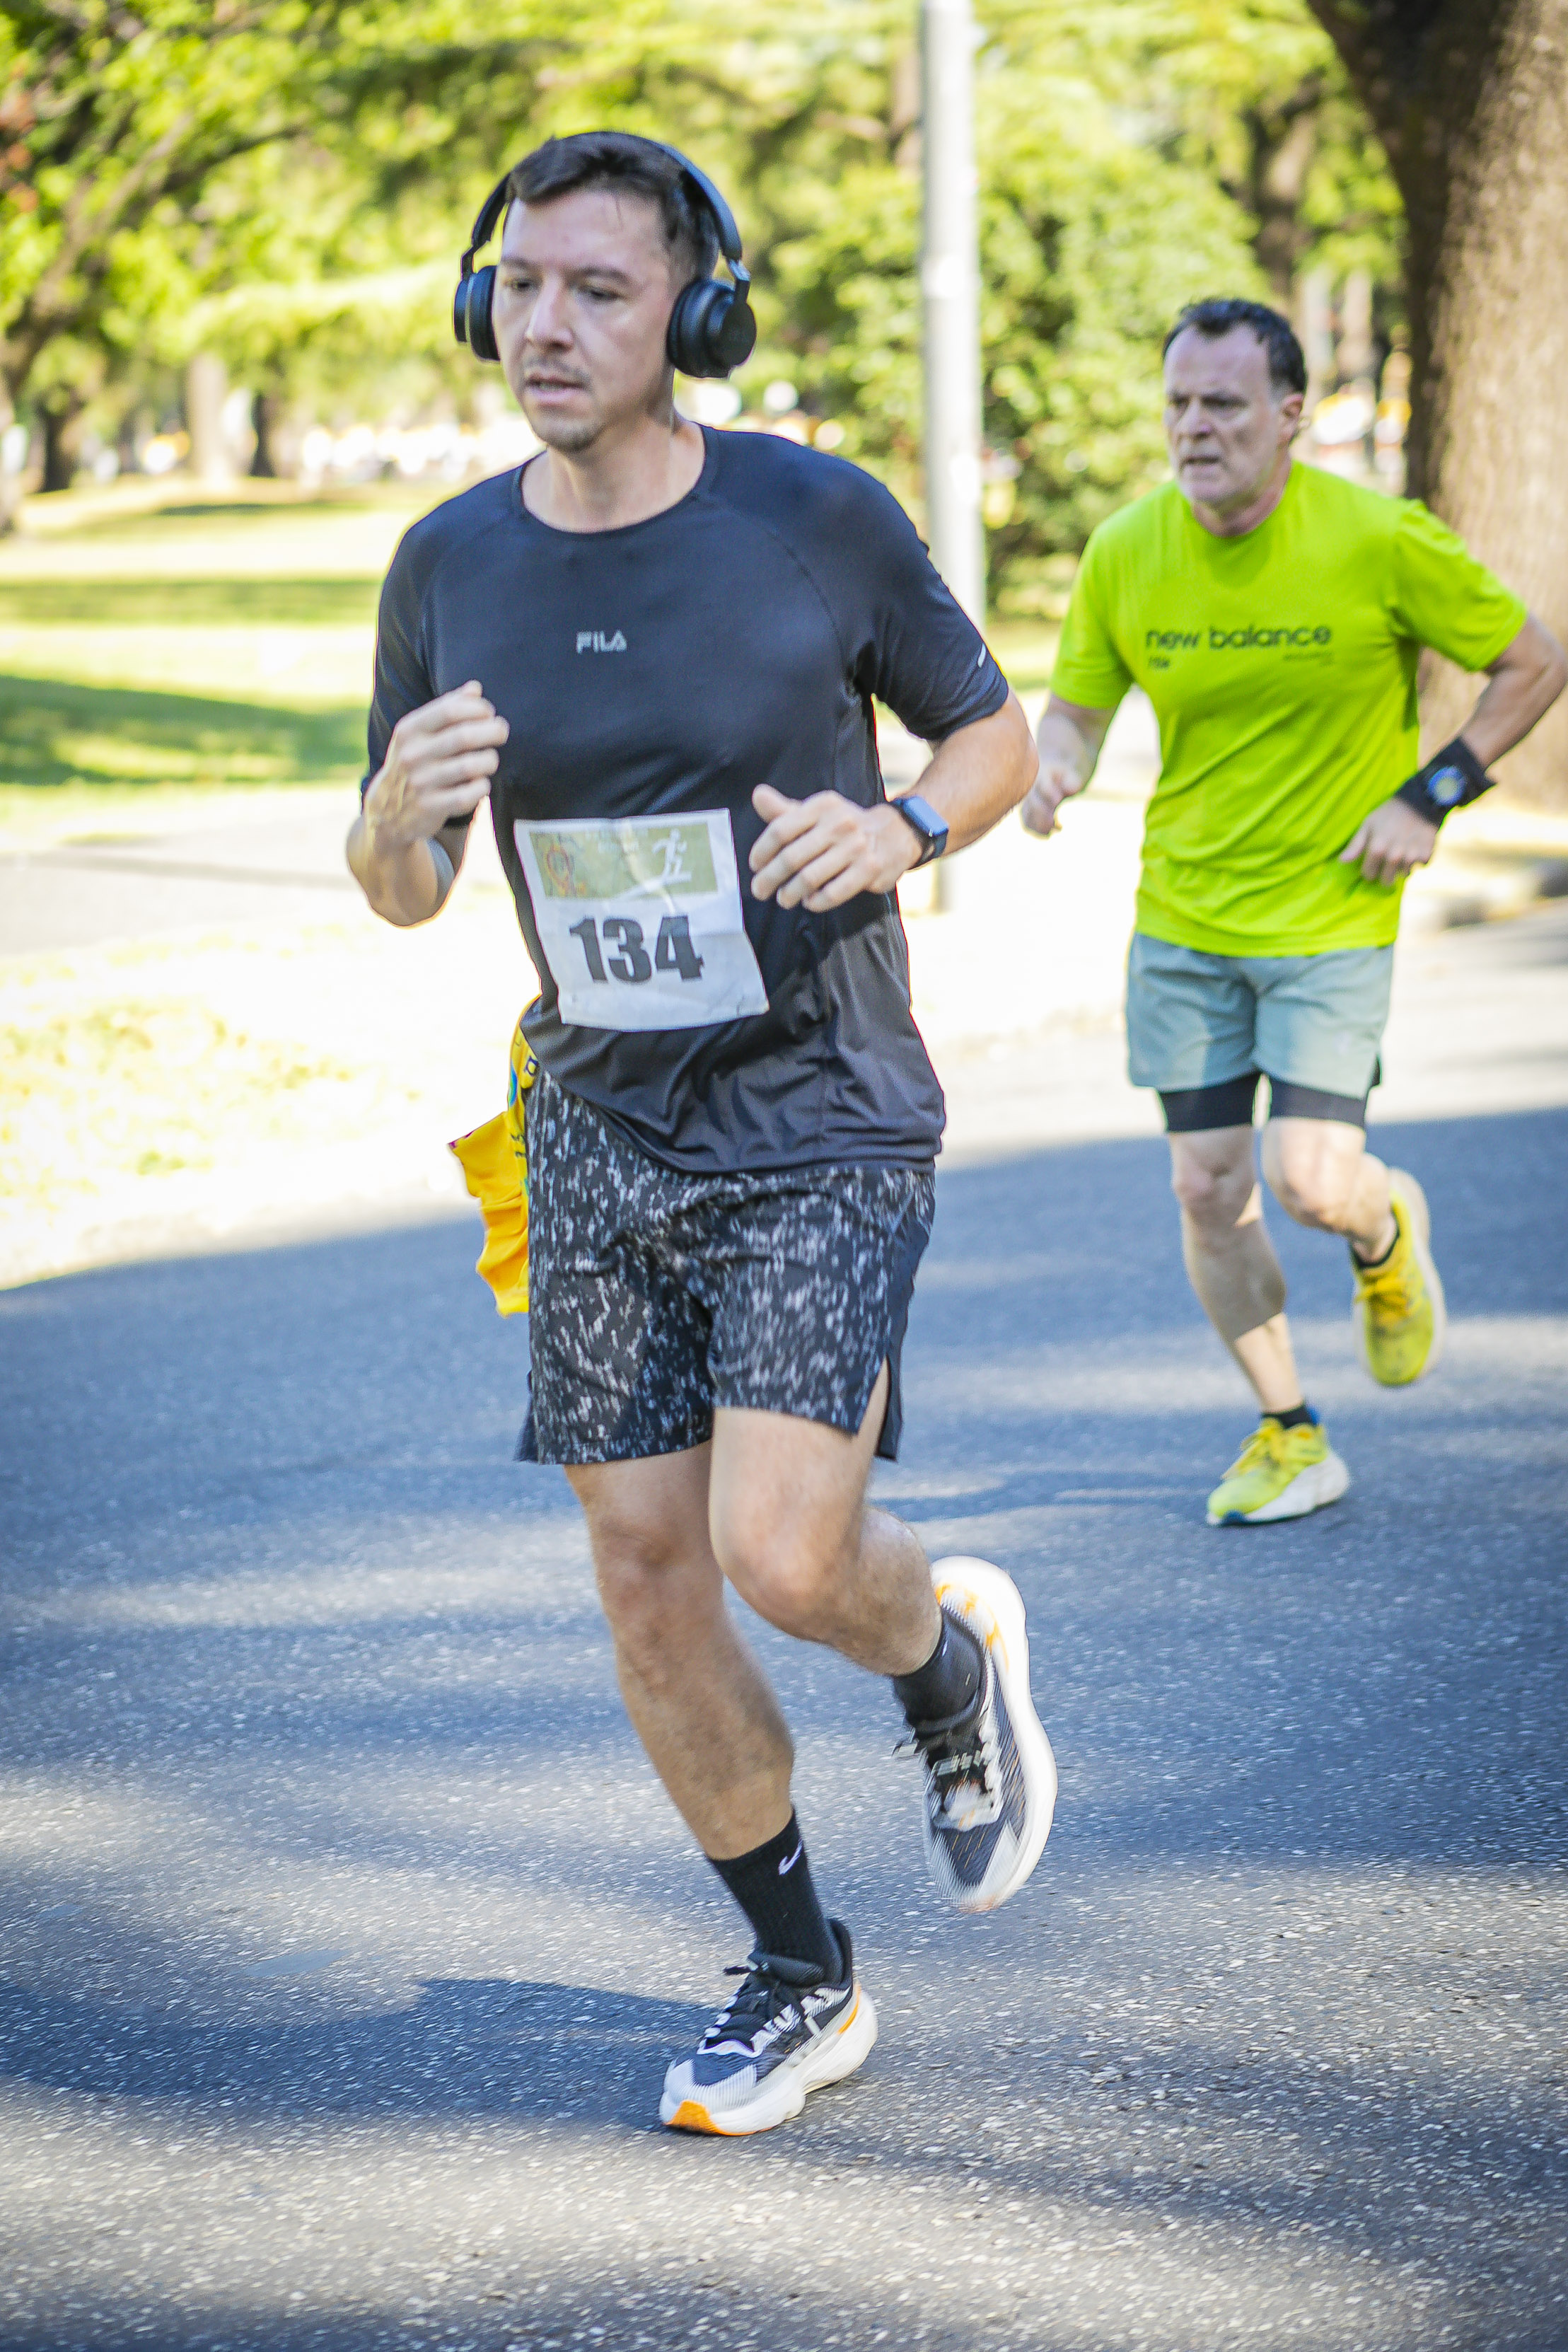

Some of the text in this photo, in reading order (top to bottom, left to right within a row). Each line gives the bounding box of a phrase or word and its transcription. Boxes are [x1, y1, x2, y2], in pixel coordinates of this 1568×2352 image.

[576, 629, 628, 654] FILA
[1146, 623, 1332, 651] new balance
[569, 915, 705, 985] 134
